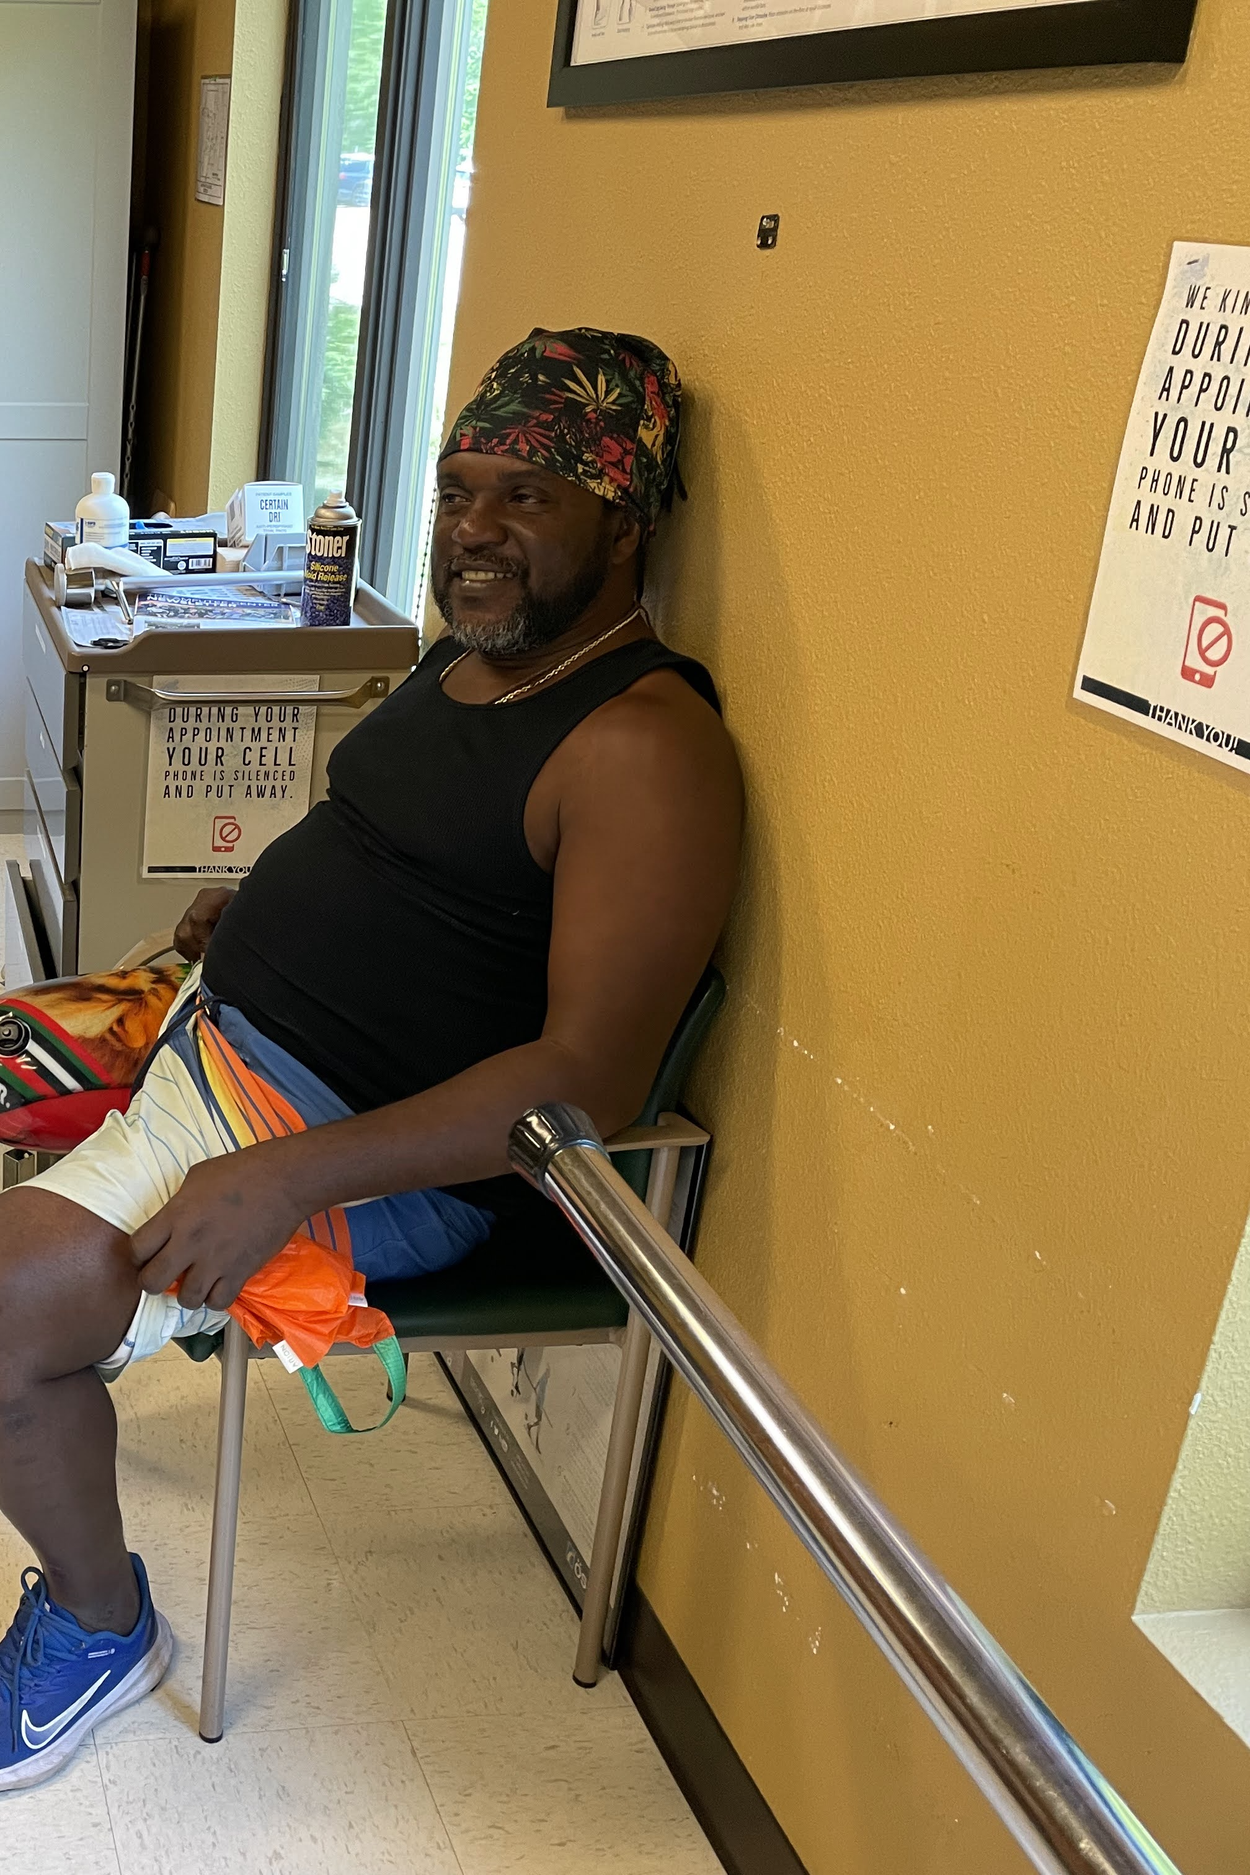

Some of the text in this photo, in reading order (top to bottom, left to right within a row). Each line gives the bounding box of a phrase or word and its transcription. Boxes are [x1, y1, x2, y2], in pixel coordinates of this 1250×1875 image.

[1185, 284, 1211, 310] WE
[1171, 318, 1250, 367] DURI
[1158, 365, 1250, 418] APPOI
[1149, 411, 1239, 475] YOUR
[1137, 466, 1199, 503] PHONE
[1208, 483, 1229, 511] IS
[259, 499, 289, 511] CERTAIN
[268, 512, 281, 523] DRI
[1129, 500, 1238, 558] AND PUT
[306, 529, 350, 558] Stoner
[168, 706, 300, 723] DURING YOUR
[166, 727, 299, 743] APPOINTMENT
[1148, 703, 1239, 755] THANK YOU!
[166, 747, 296, 767] YOUR CELL
[164, 770, 295, 781] PHONE IS SILENCED
[163, 784, 293, 799] AND PUT AWAY.
